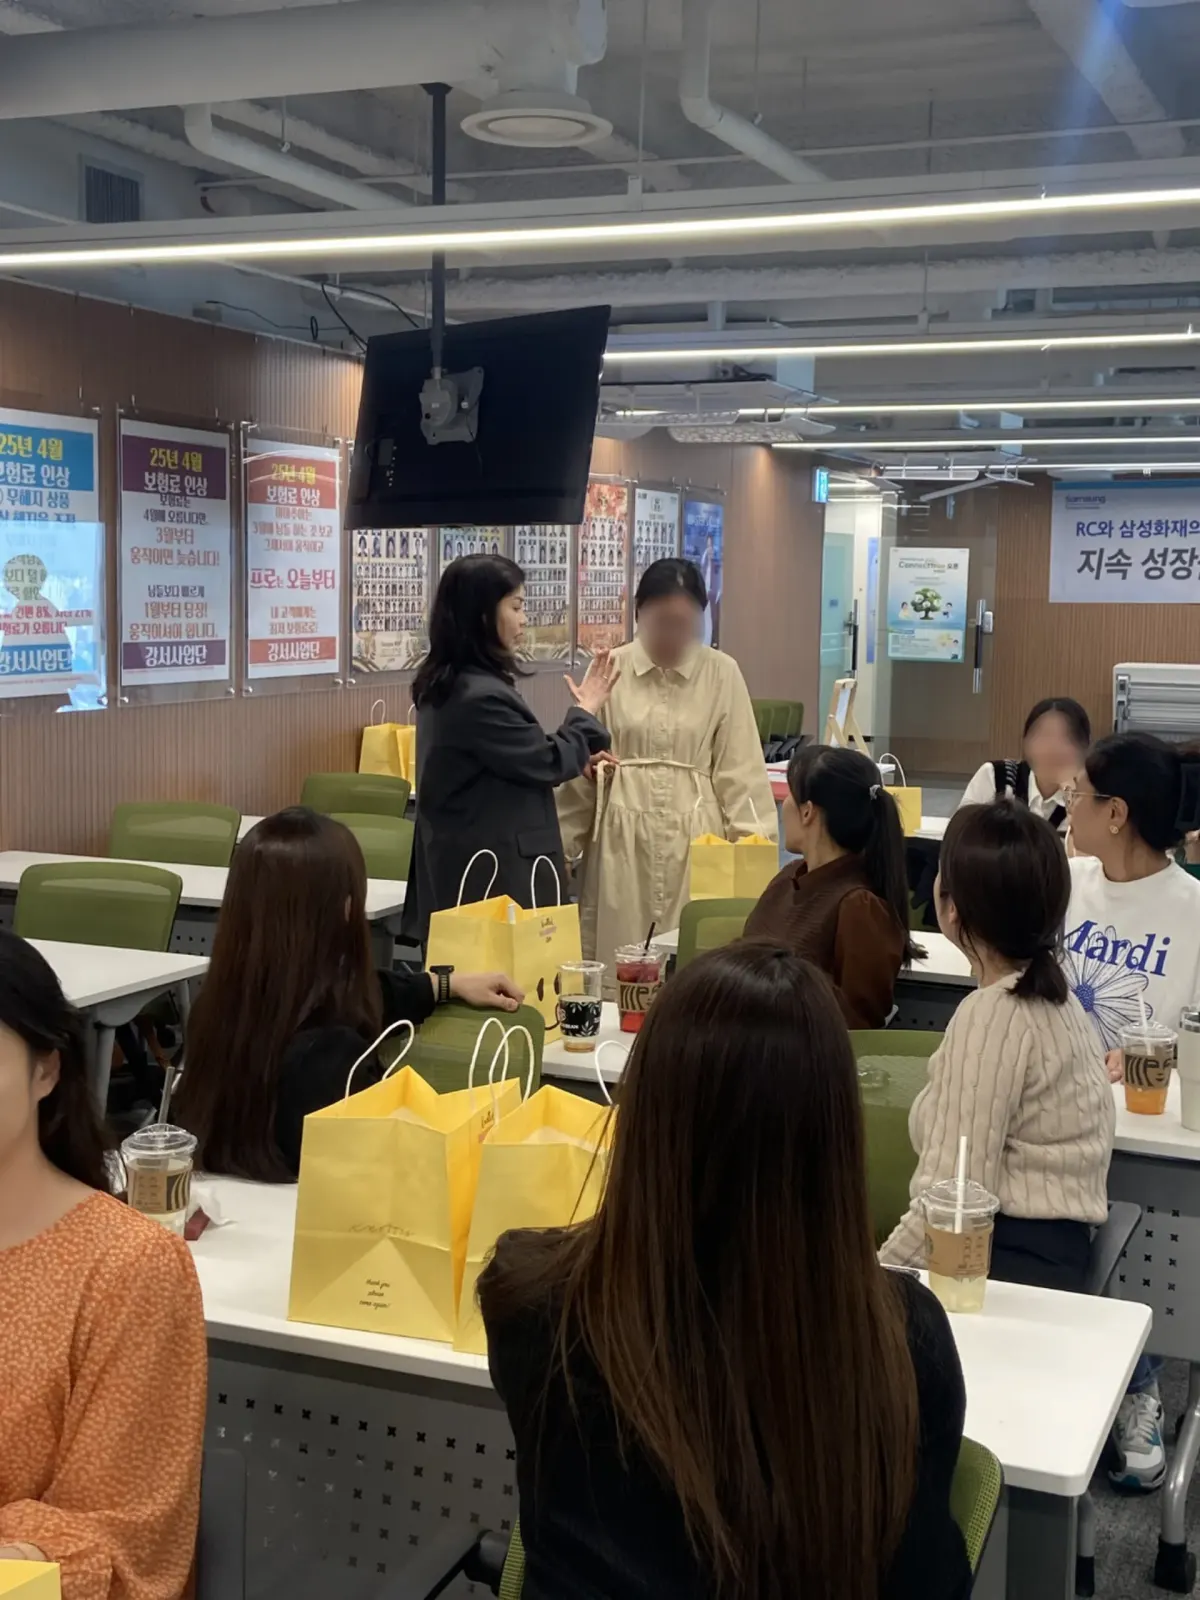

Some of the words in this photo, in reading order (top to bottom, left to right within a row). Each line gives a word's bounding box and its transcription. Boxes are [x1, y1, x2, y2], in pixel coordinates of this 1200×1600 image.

[37, 437, 63, 461] 4월
[149, 447, 179, 469] 25년
[182, 451, 202, 473] 4월
[40, 464, 70, 488] 인상
[144, 471, 181, 494] 보험료
[184, 475, 208, 497] 인상
[266, 485, 297, 505] 보험료
[300, 487, 320, 507] 인상
[156, 526, 195, 545] 3월부터
[1076, 520, 1114, 538] RC와
[130, 546, 173, 567] 움직이면
[1077, 547, 1133, 580] 지속
[1141, 547, 1200, 580] 성장
[250, 567, 283, 589] 프로는
[287, 567, 336, 591] 오늘부터
[144, 644, 208, 668] 강서사업단
[268, 641, 320, 662] 강서사업단
